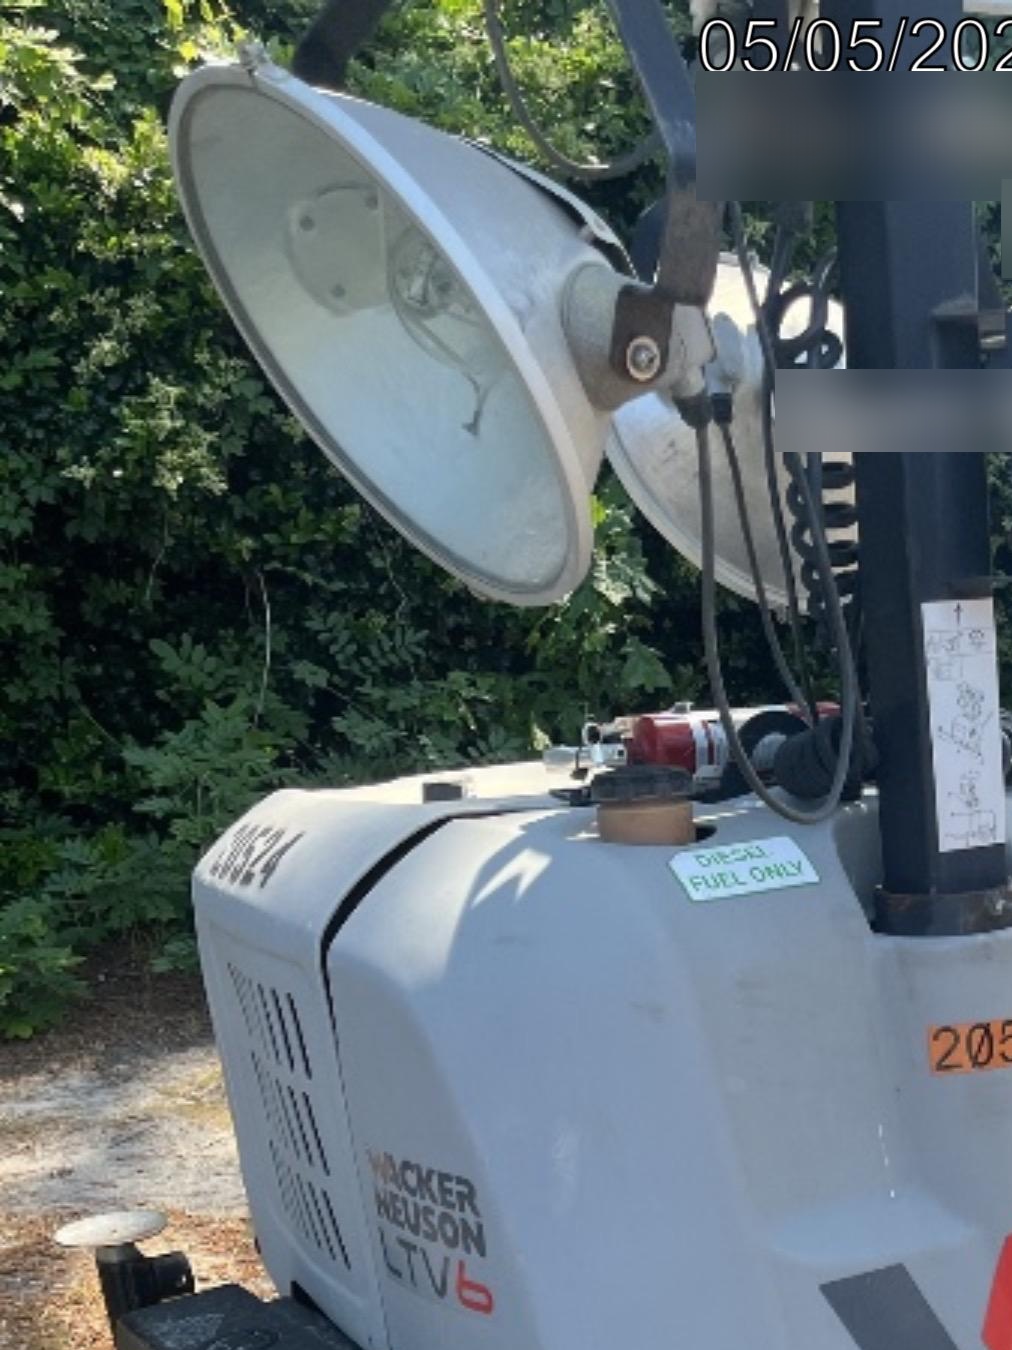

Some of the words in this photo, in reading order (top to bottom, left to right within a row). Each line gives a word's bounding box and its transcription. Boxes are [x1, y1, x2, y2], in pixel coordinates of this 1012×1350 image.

[690, 869, 747, 890] FUEL
[751, 860, 804, 881] ONLY
[694, 846, 767, 867] DIESEL
[375, 1189, 487, 1258] NEUSON
[378, 1226, 494, 1315] LTV6
